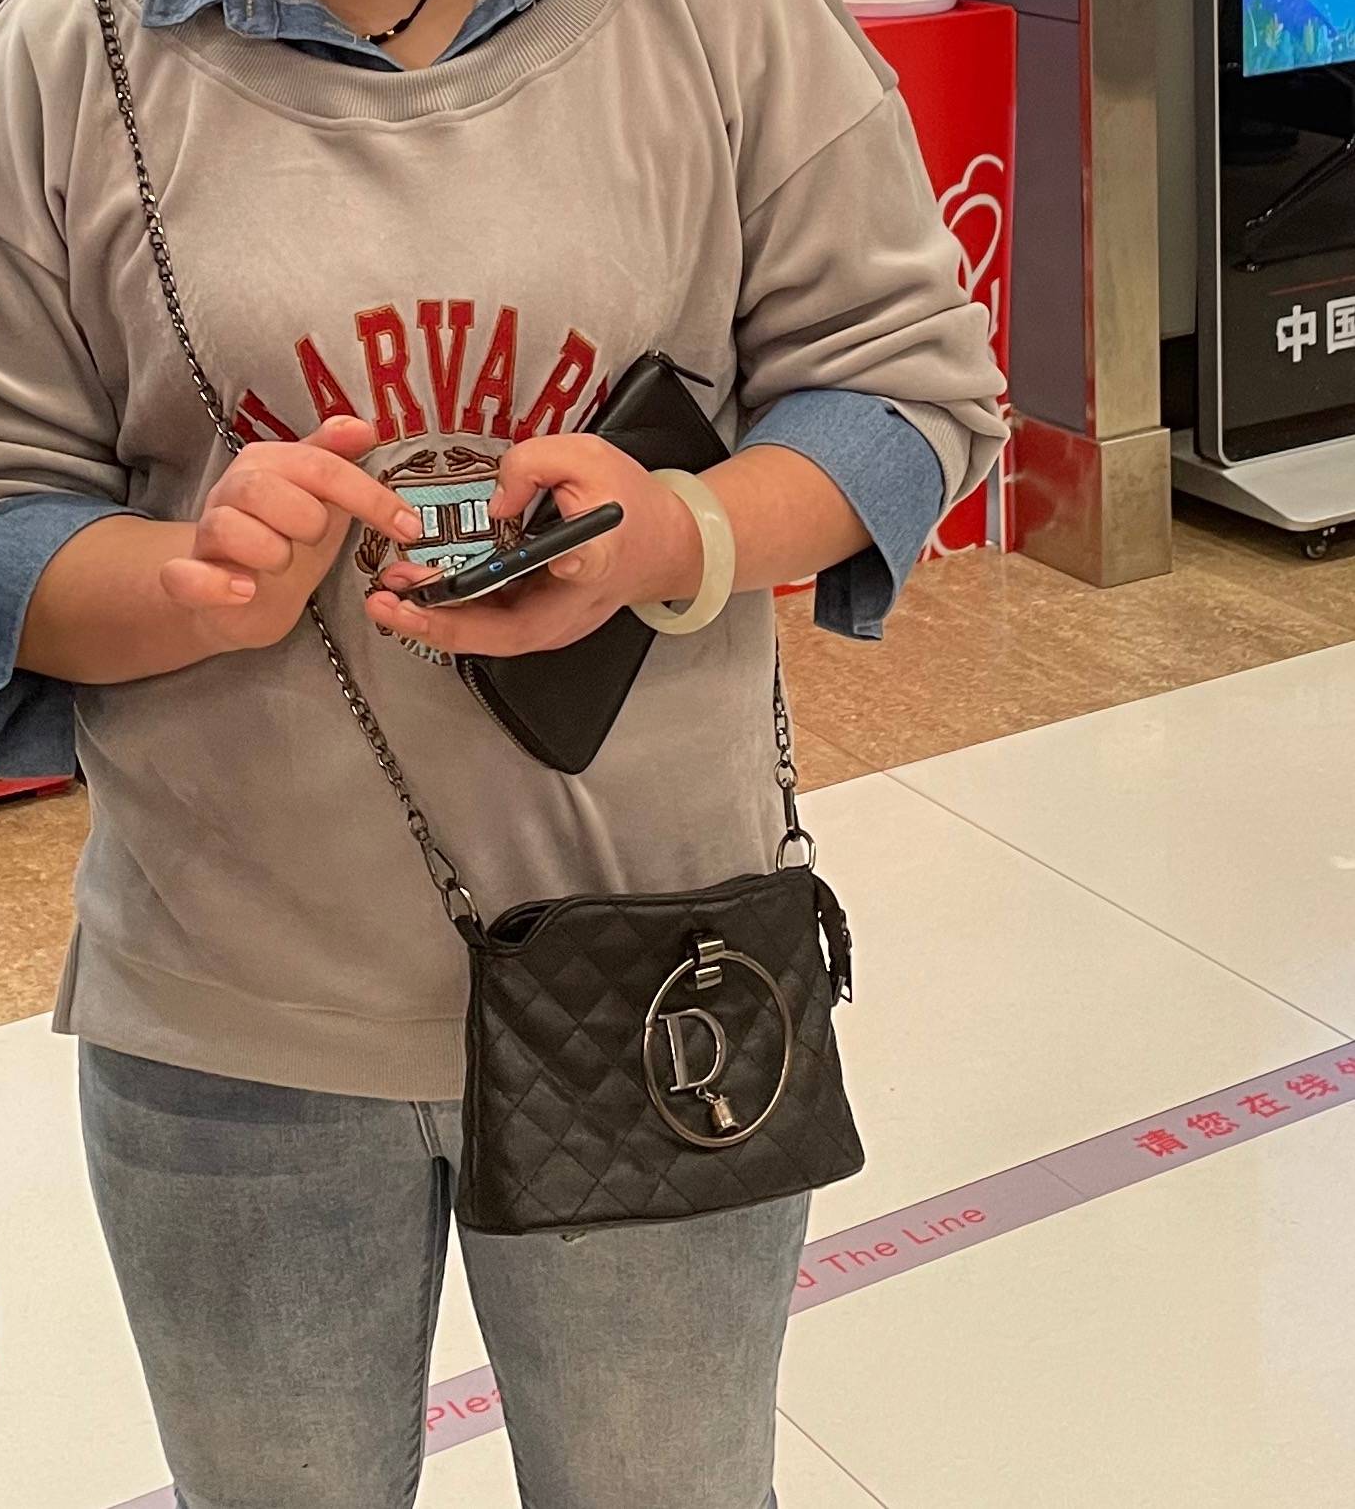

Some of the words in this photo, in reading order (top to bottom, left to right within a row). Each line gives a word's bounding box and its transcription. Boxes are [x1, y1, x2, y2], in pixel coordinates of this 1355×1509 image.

[1276, 296, 1355, 363] 中国
[234, 298, 610, 447] ARVAR
[818, 1242, 898, 1274] The
[902, 1209, 986, 1245] Line
